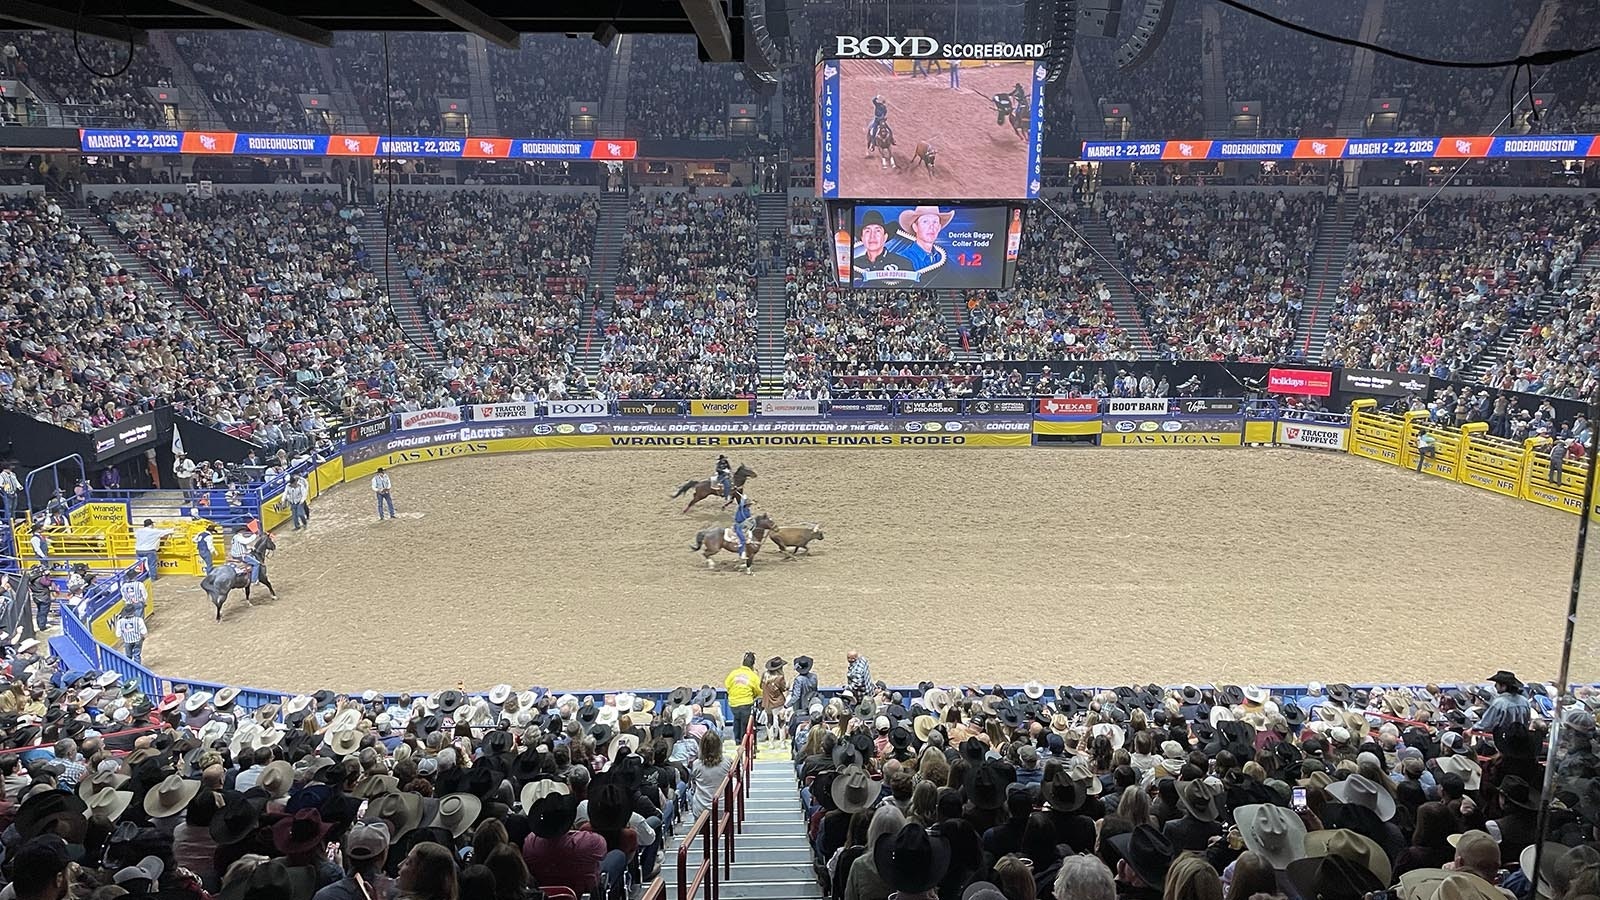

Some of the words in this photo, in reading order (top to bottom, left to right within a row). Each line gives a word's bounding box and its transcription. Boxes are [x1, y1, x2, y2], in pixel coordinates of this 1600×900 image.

[835, 36, 938, 56] BOYD
[942, 44, 1044, 58] SCOREBOARD
[88, 135, 123, 148] MARCH
[153, 134, 178, 147] 2026
[382, 142, 412, 152] MARCH
[439, 141, 460, 152] 2026
[824, 122, 832, 173] VEGAS
[1088, 144, 1115, 157] MARCH
[1140, 144, 1160, 155] 2026
[1349, 143, 1380, 154] MARCH
[1410, 141, 1433, 152] 2026
[973, 232, 993, 240] Begay
[958, 254, 982, 266] 1.2
[1271, 377, 1304, 387] holidays
[552, 404, 604, 414] BOYD
[702, 403, 738, 413] Wrangler
[1302, 429, 1338, 438] TRACTOR
[387, 437, 430, 449] CONQUER
[434, 433, 457, 442] WITH
[611, 437, 721, 446] WRANGLER
[728, 437, 822, 445] NATIONAL
[828, 436, 893, 444] FINALS
[900, 436, 965, 445] RODEO
[1122, 435, 1155, 444] LAS
[1161, 434, 1221, 444] VEGAS
[1301, 435, 1328, 444] SUPPLY
[388, 450, 420, 465] LAS
[426, 443, 488, 458] VEGAS
[1382, 450, 1396, 459] NFR
[1437, 464, 1452, 474] NFR
[1497, 480, 1514, 491] NFR
[1563, 497, 1582, 508] NFR
[92, 506, 122, 514] Wrangler
[93, 514, 123, 523] Wrangler
